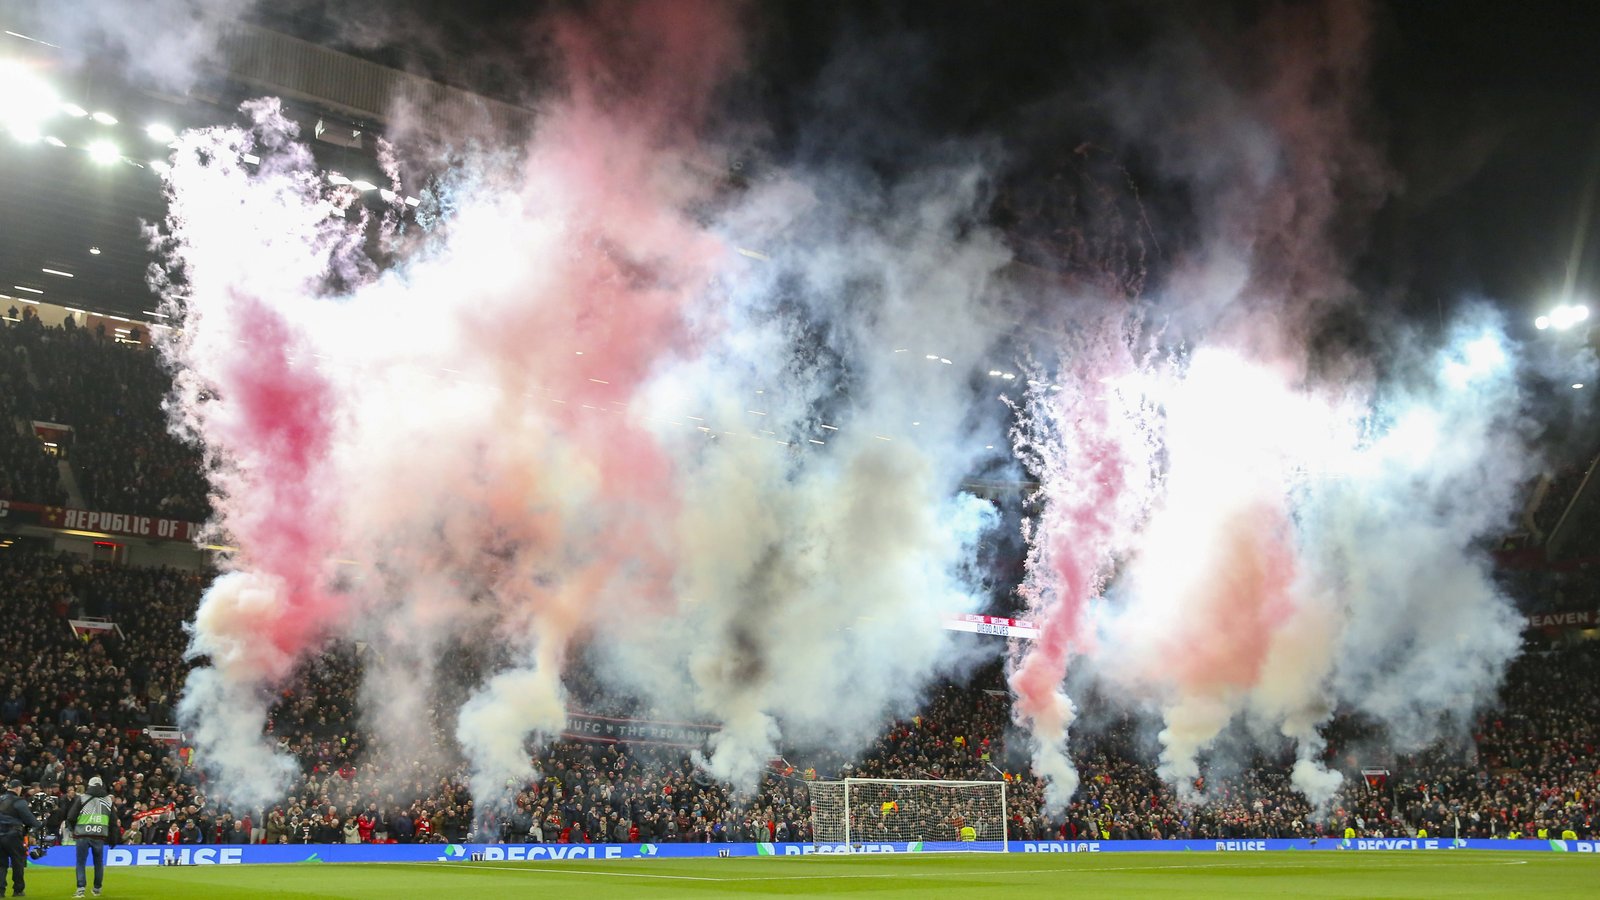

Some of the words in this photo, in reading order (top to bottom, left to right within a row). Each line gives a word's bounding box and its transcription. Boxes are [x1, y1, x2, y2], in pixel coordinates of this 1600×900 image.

[158, 519, 179, 538] OF
[1525, 612, 1589, 627] EAVEN
[977, 623, 992, 634] DIEGO
[993, 624, 1009, 635] ALVES
[619, 726, 645, 737] THE
[651, 728, 673, 739] RED
[678, 730, 708, 741] ARM
[85, 825, 103, 833] 046
